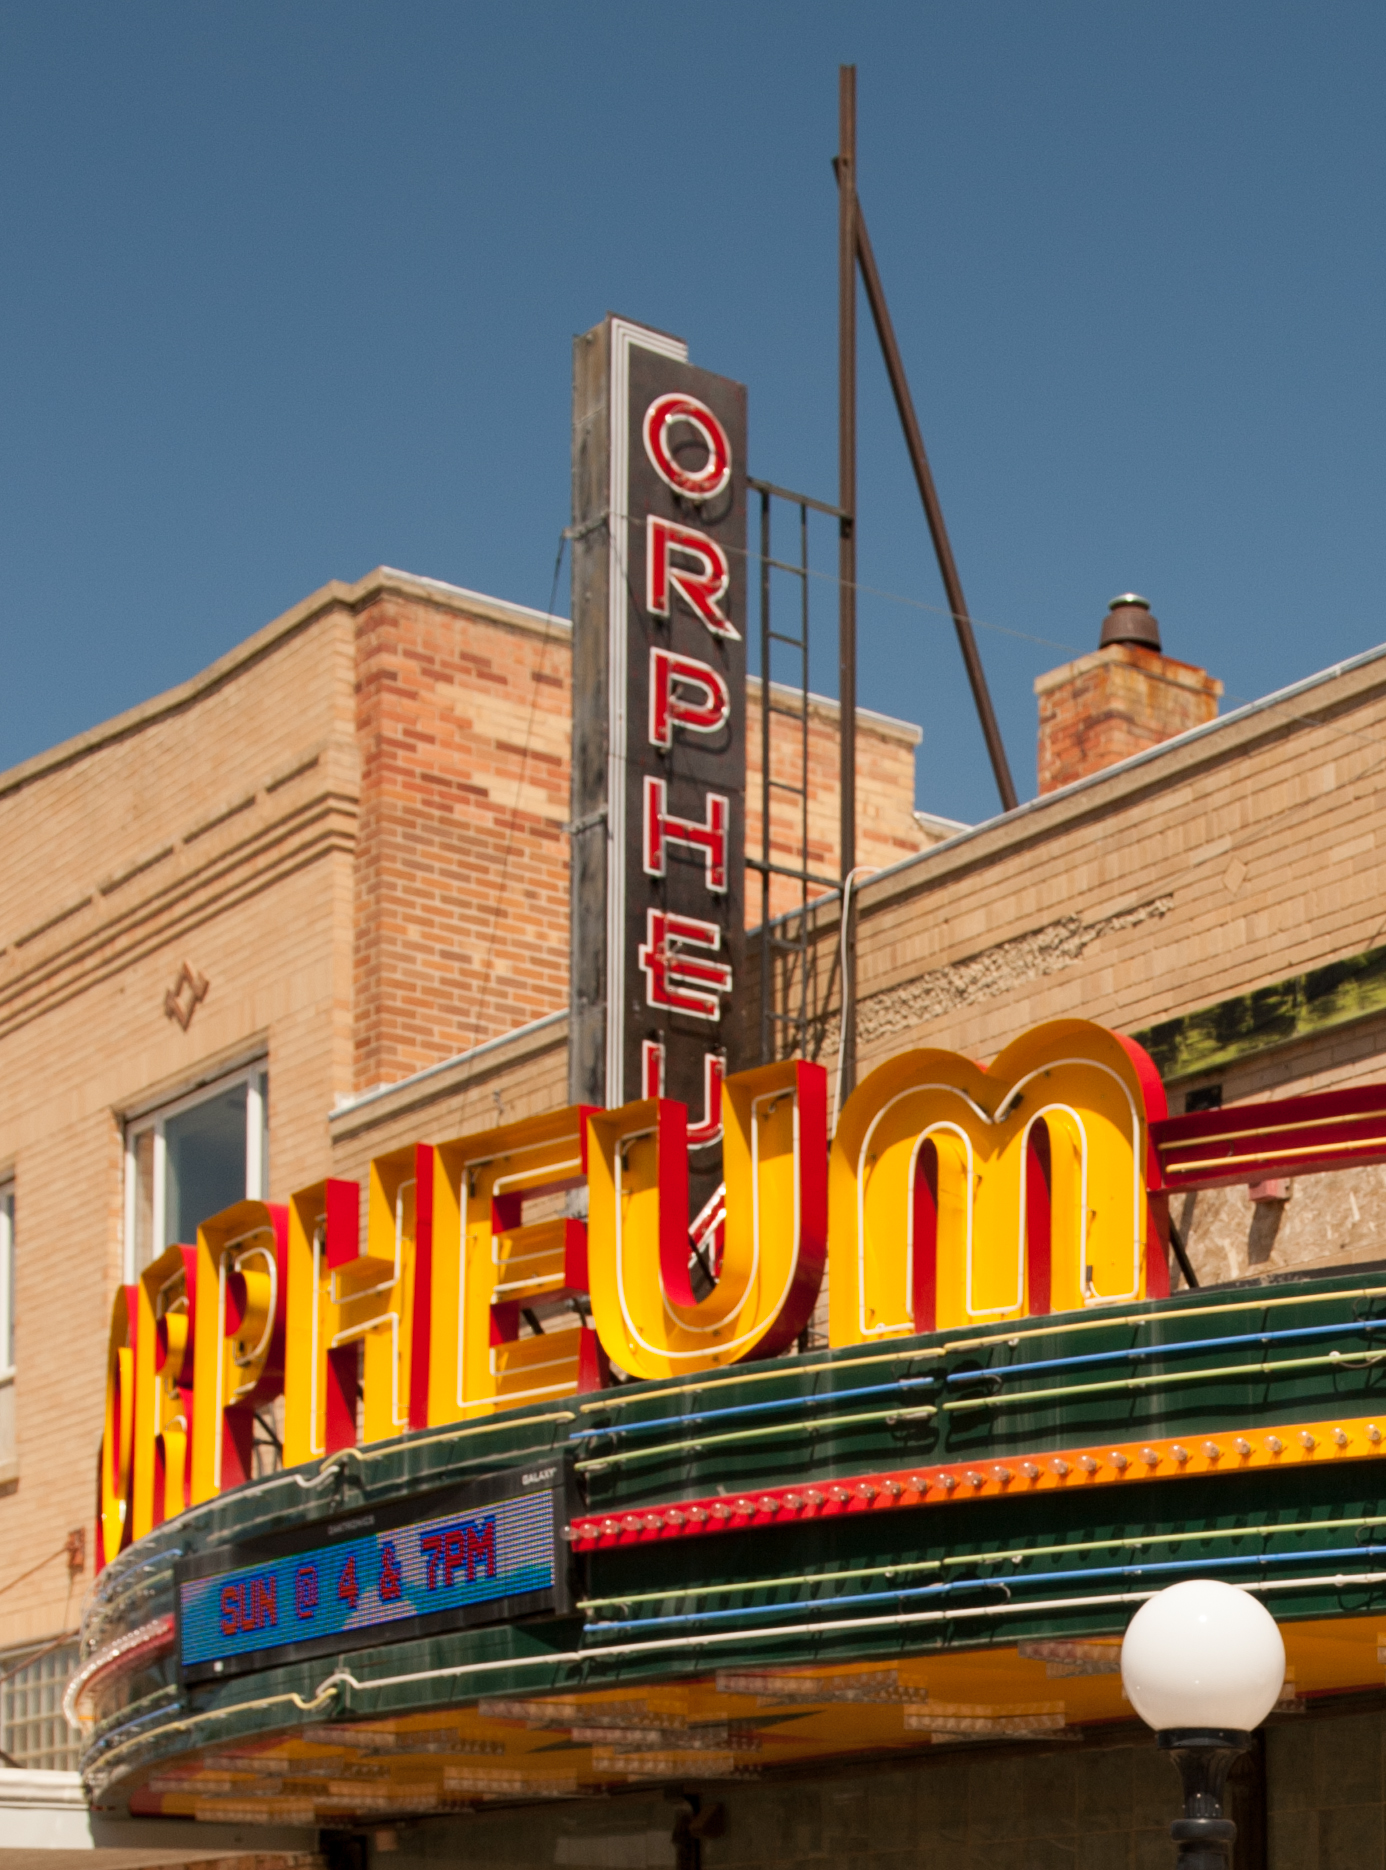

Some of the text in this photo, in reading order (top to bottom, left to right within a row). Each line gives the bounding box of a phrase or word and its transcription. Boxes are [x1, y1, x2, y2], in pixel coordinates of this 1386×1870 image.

[522, 1467, 555, 1486] GALAXY
[220, 1521, 497, 1635] SUN @ 4 & 7PM
